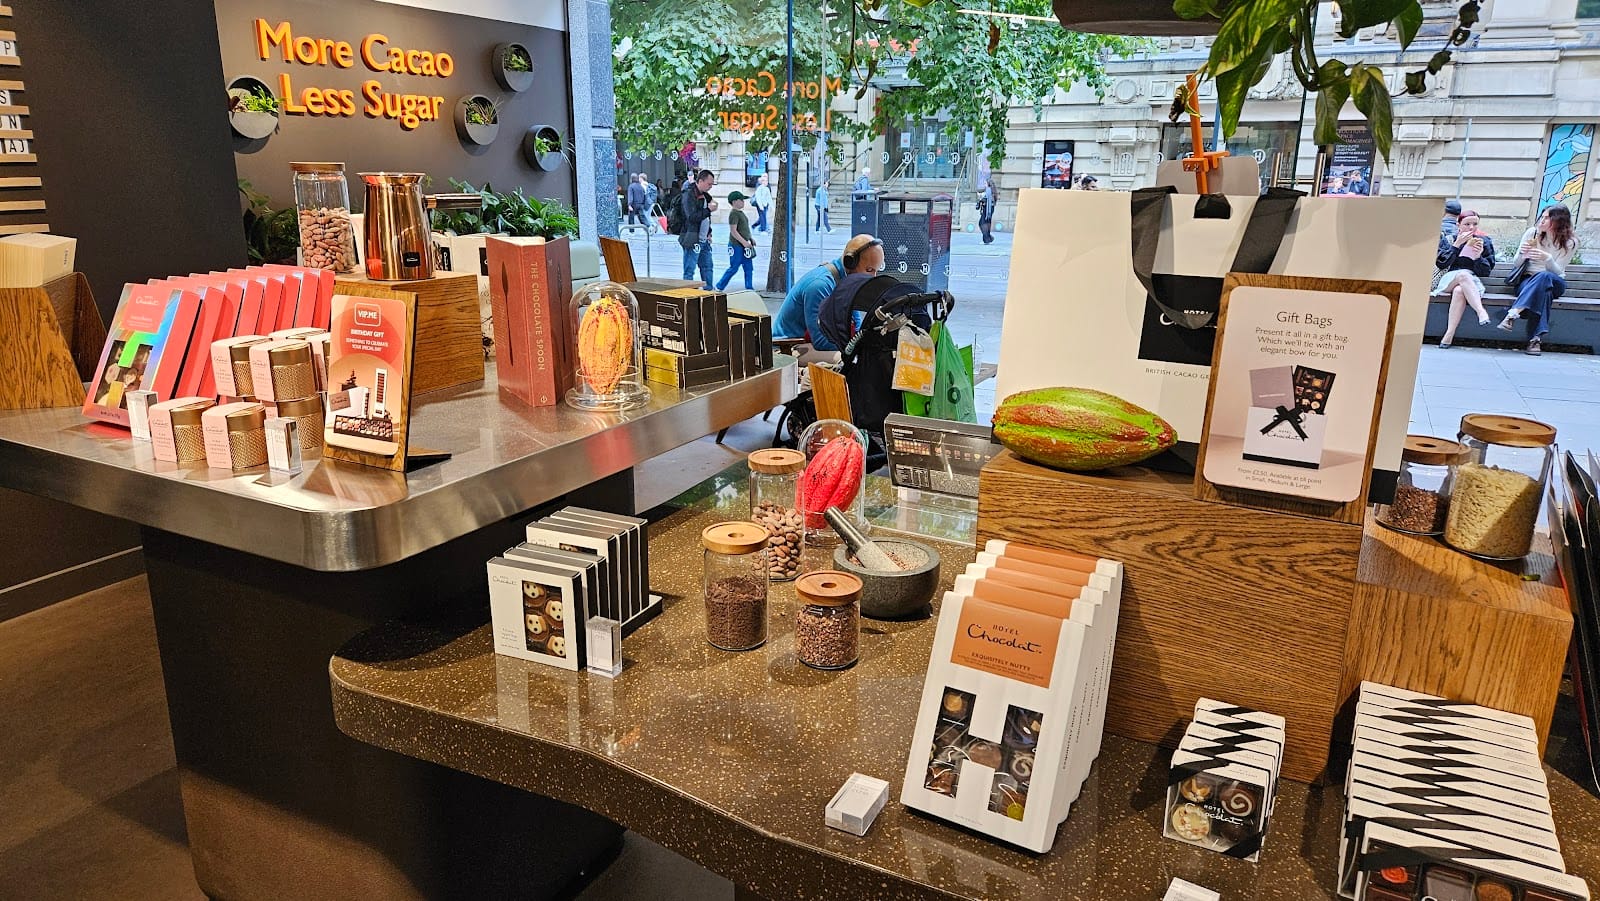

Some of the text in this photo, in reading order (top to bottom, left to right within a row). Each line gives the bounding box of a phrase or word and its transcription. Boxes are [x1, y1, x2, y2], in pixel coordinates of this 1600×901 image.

[255, 18, 454, 77] More Cacao
[279, 72, 444, 131] Less Sugar
[529, 262, 545, 371] THE CHOCOLATE SPOON
[1276, 311, 1333, 328] Gift Bags
[1255, 326, 1284, 337] Present
[1293, 330, 1301, 338] all
[1319, 333, 1332, 342] gift
[1334, 334, 1349, 344] bag.
[1257, 336, 1282, 345] Which
[1285, 339, 1301, 347] we'll
[1260, 346, 1287, 355] elegant
[1289, 348, 1306, 356] bow
[1308, 349, 1320, 357] for
[1145, 368, 1171, 376] BRITISH
[1173, 371, 1198, 379] CACAO
[967, 623, 1042, 653] Chocolat
[992, 624, 1019, 636] HOTEL
[971, 652, 1031, 672] EXQUISITELY NUTTY
[1203, 804, 1225, 814] HOTEL
